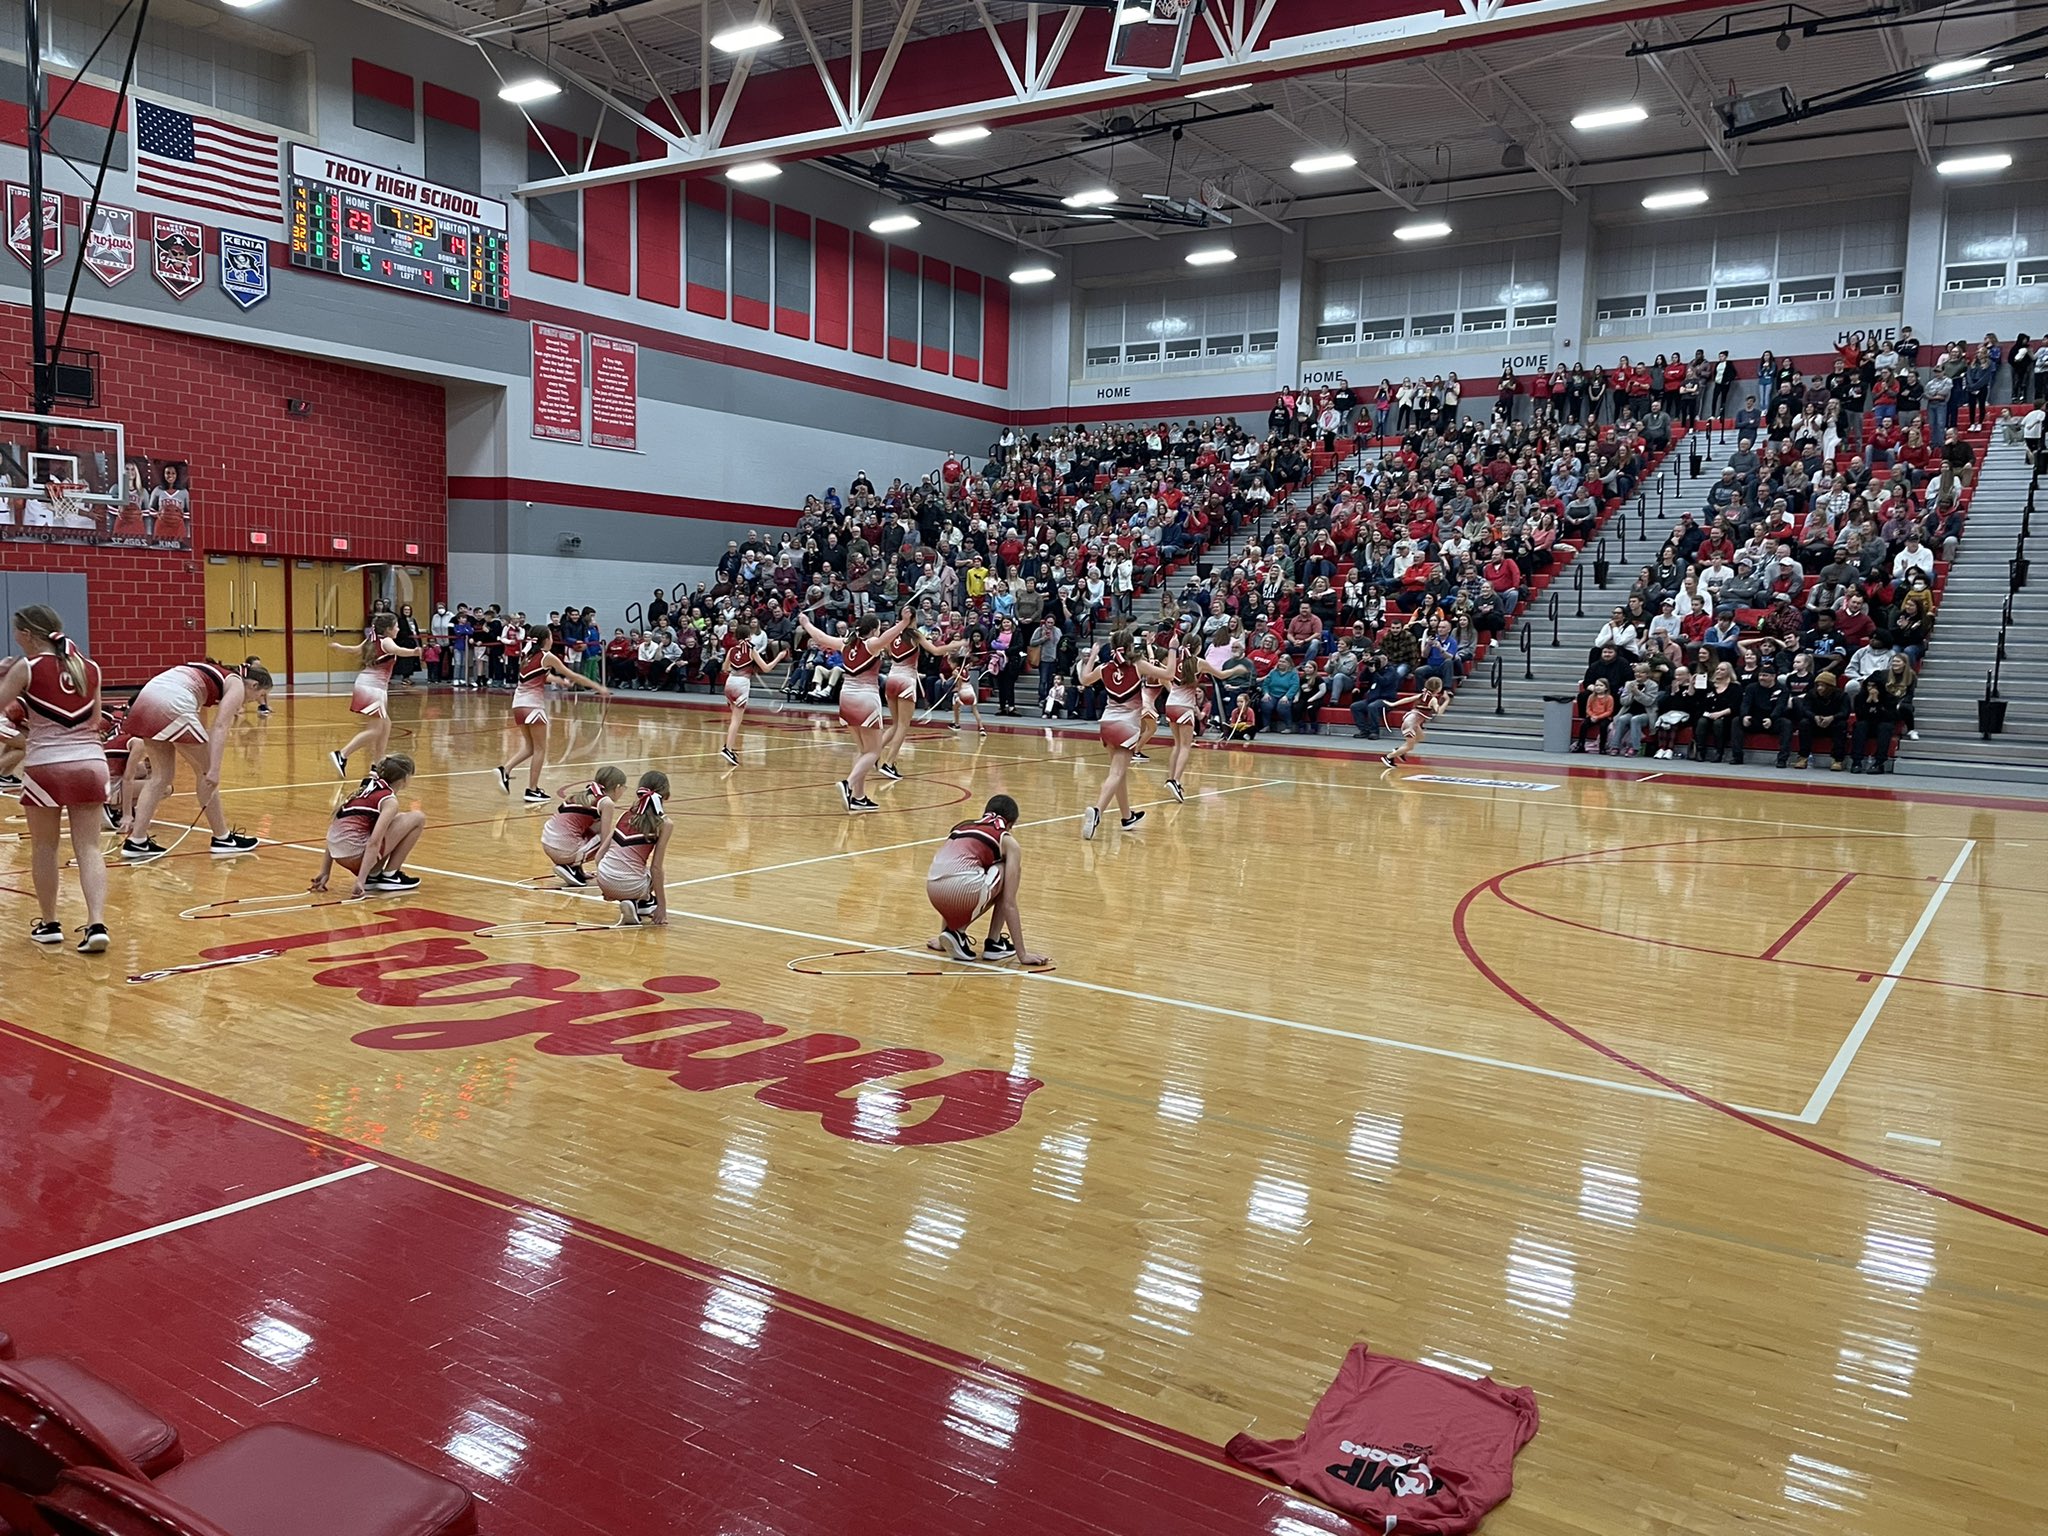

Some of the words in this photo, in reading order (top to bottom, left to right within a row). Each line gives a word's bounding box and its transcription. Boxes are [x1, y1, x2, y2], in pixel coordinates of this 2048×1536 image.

[11, 189, 58, 204] TIPPNOE
[298, 188, 306, 199] 4
[318, 193, 323, 203] 1
[325, 160, 372, 188] TROY
[375, 174, 417, 200] HIGH
[420, 187, 481, 218] SCHOOL
[296, 200, 306, 212] 14
[315, 205, 323, 216] 0
[331, 209, 338, 220] 0
[345, 196, 370, 210] HOME
[296, 213, 306, 226] 15
[319, 219, 323, 229] 1
[331, 223, 338, 233] 4
[349, 209, 372, 233] 23
[390, 208, 434, 237] 7:32
[439, 219, 468, 235] VISITOR
[225, 236, 263, 250] XENIA
[292, 225, 306, 238] 32
[315, 231, 323, 242] 0
[331, 235, 338, 246] 0
[354, 233, 375, 244] BONUS
[390, 237, 412, 249] PERIOD
[489, 237, 496, 248] 0
[292, 239, 307, 252] 34
[315, 244, 323, 256] 0
[331, 249, 338, 260] 2
[352, 244, 371, 255] FOULS
[414, 241, 424, 257] 2
[451, 236, 466, 256] 14
[475, 246, 482, 256] 2
[361, 254, 372, 271] 5
[437, 253, 456, 264] BONUS
[475, 259, 482, 269] 4
[489, 261, 496, 272] 0
[382, 260, 392, 275] 4
[393, 262, 422, 276] TIMEOUTS
[442, 266, 460, 277] FOULS
[400, 271, 415, 281] LEFT
[424, 269, 434, 285] 4
[473, 270, 482, 280] 10
[503, 276, 509, 287] 0
[450, 277, 460, 291] 4
[470, 281, 483, 292] 21
[503, 288, 509, 299] 0
[1838, 327, 1896, 344] HOME
[1502, 354, 1548, 369] HOME
[1303, 370, 1343, 384] HOME
[1097, 386, 1131, 399] HOME
[198, 907, 1045, 1147] Trojans
